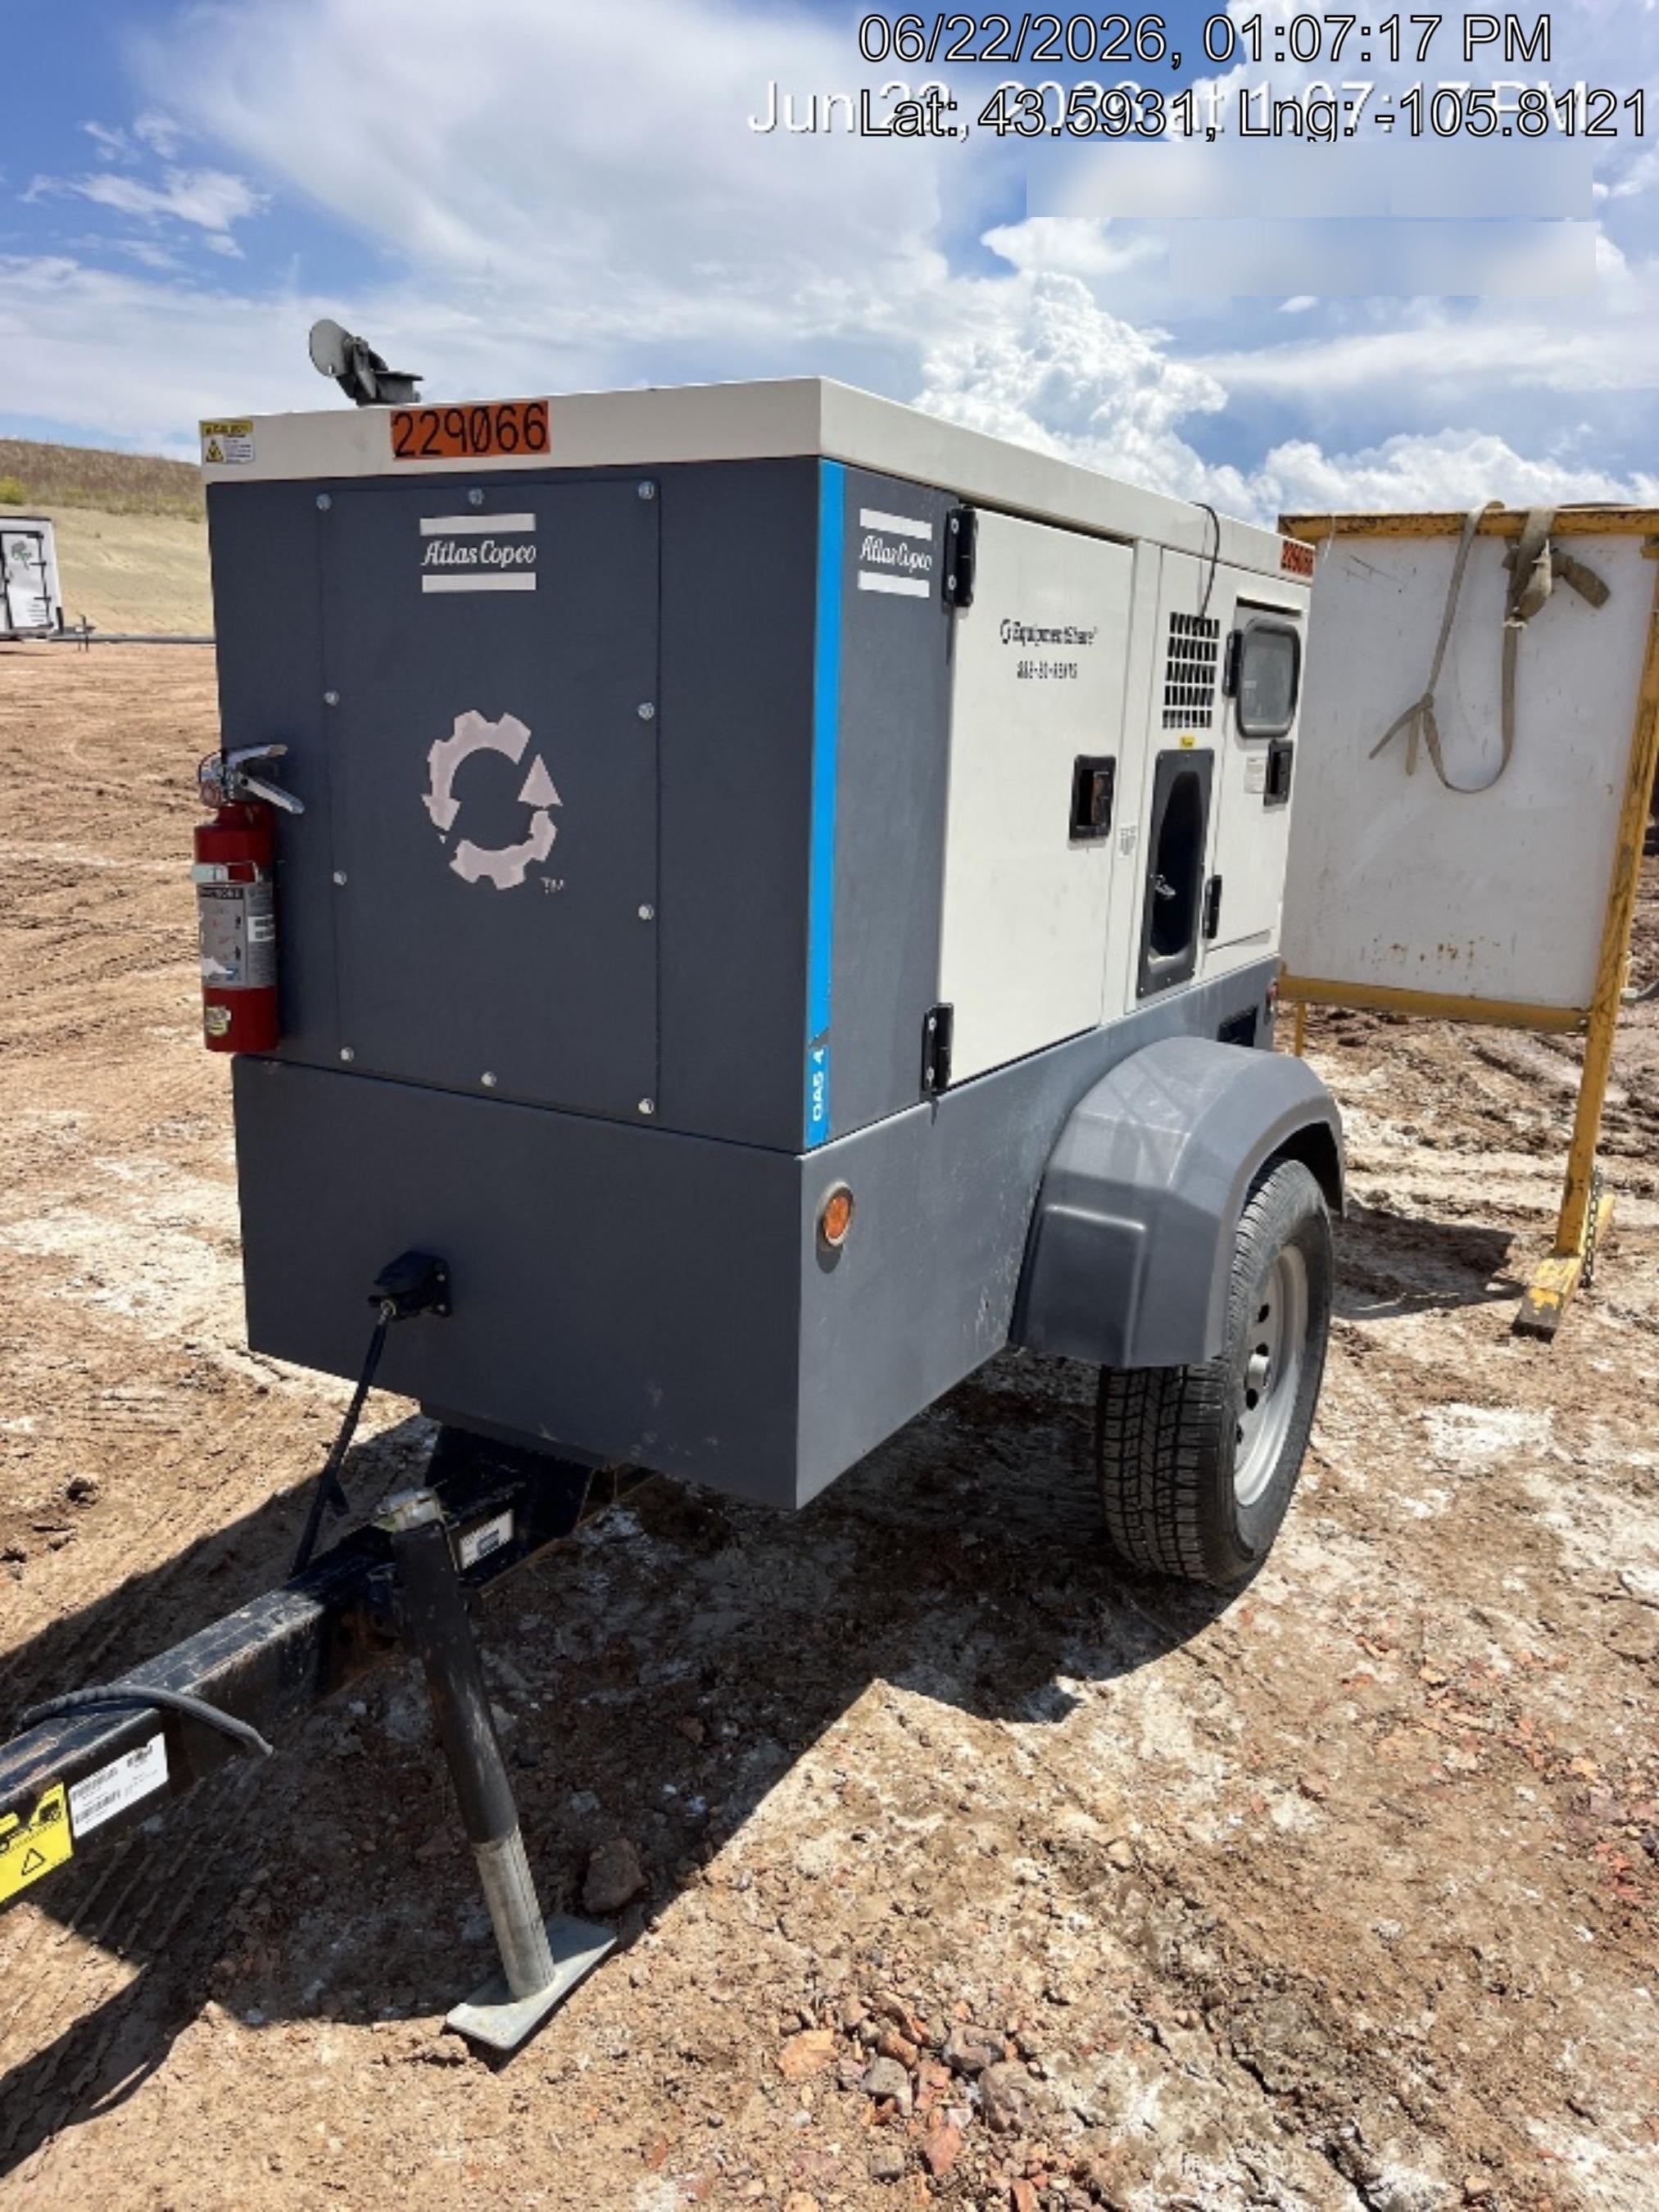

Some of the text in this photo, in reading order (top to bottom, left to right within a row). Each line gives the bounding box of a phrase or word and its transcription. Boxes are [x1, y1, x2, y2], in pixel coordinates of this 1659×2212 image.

[392, 402, 548, 457] 229066
[420, 540, 537, 568] Atlas Copco
[859, 535, 932, 573] Atlas Copco
